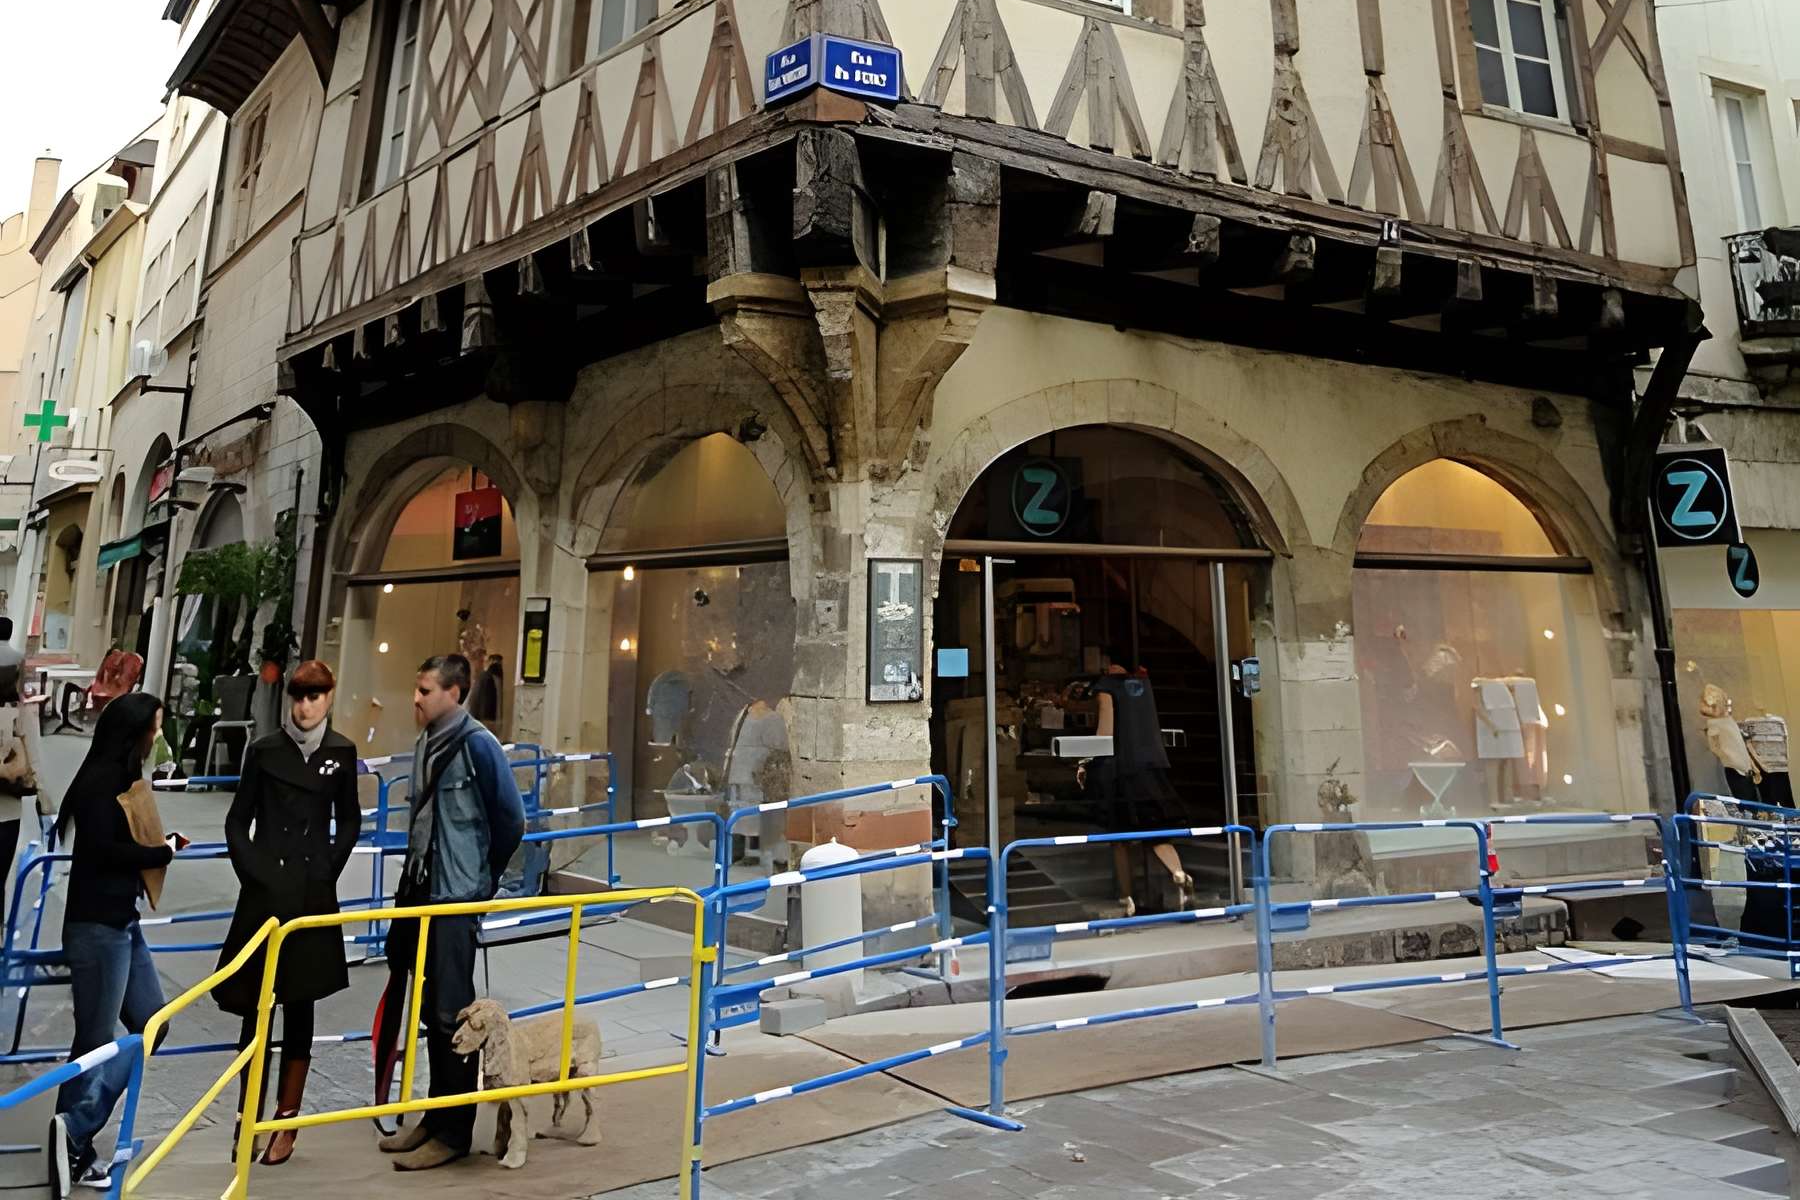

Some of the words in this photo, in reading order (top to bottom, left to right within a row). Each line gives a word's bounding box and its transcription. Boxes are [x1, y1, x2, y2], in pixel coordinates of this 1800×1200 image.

[1023, 468, 1060, 524] Z
[1666, 470, 1717, 526] Z
[1730, 547, 1756, 590] Z
